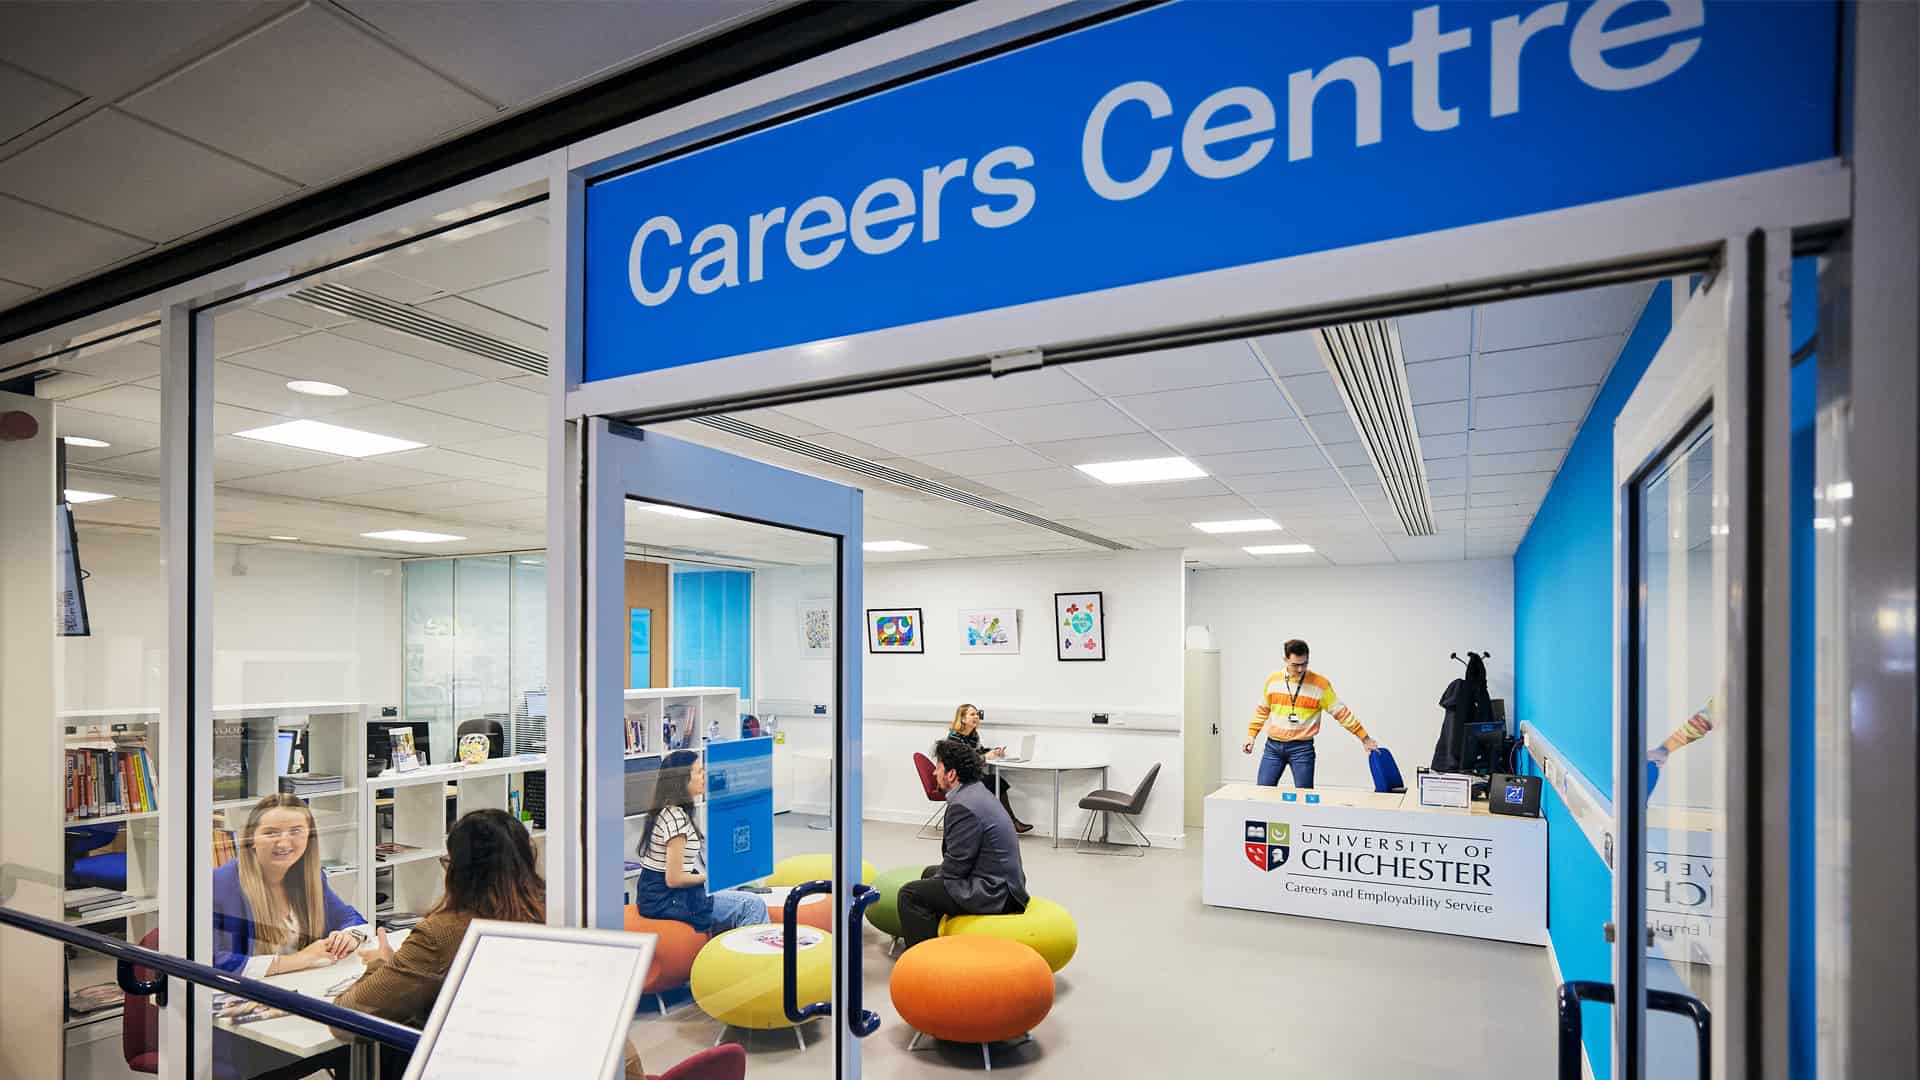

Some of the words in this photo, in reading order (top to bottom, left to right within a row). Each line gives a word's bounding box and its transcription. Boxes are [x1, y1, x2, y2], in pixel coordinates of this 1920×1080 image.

[628, 145, 1036, 307] Careers
[1081, 0, 1705, 201] Centre
[1301, 831, 1448, 855] UNIVERSITY
[1464, 845, 1494, 859] OF
[1301, 848, 1493, 887] CHICHESTER
[1285, 881, 1328, 896] Careers
[1331, 887, 1354, 899] and
[1357, 888, 1440, 911] Employability
[1445, 898, 1493, 914] Service
